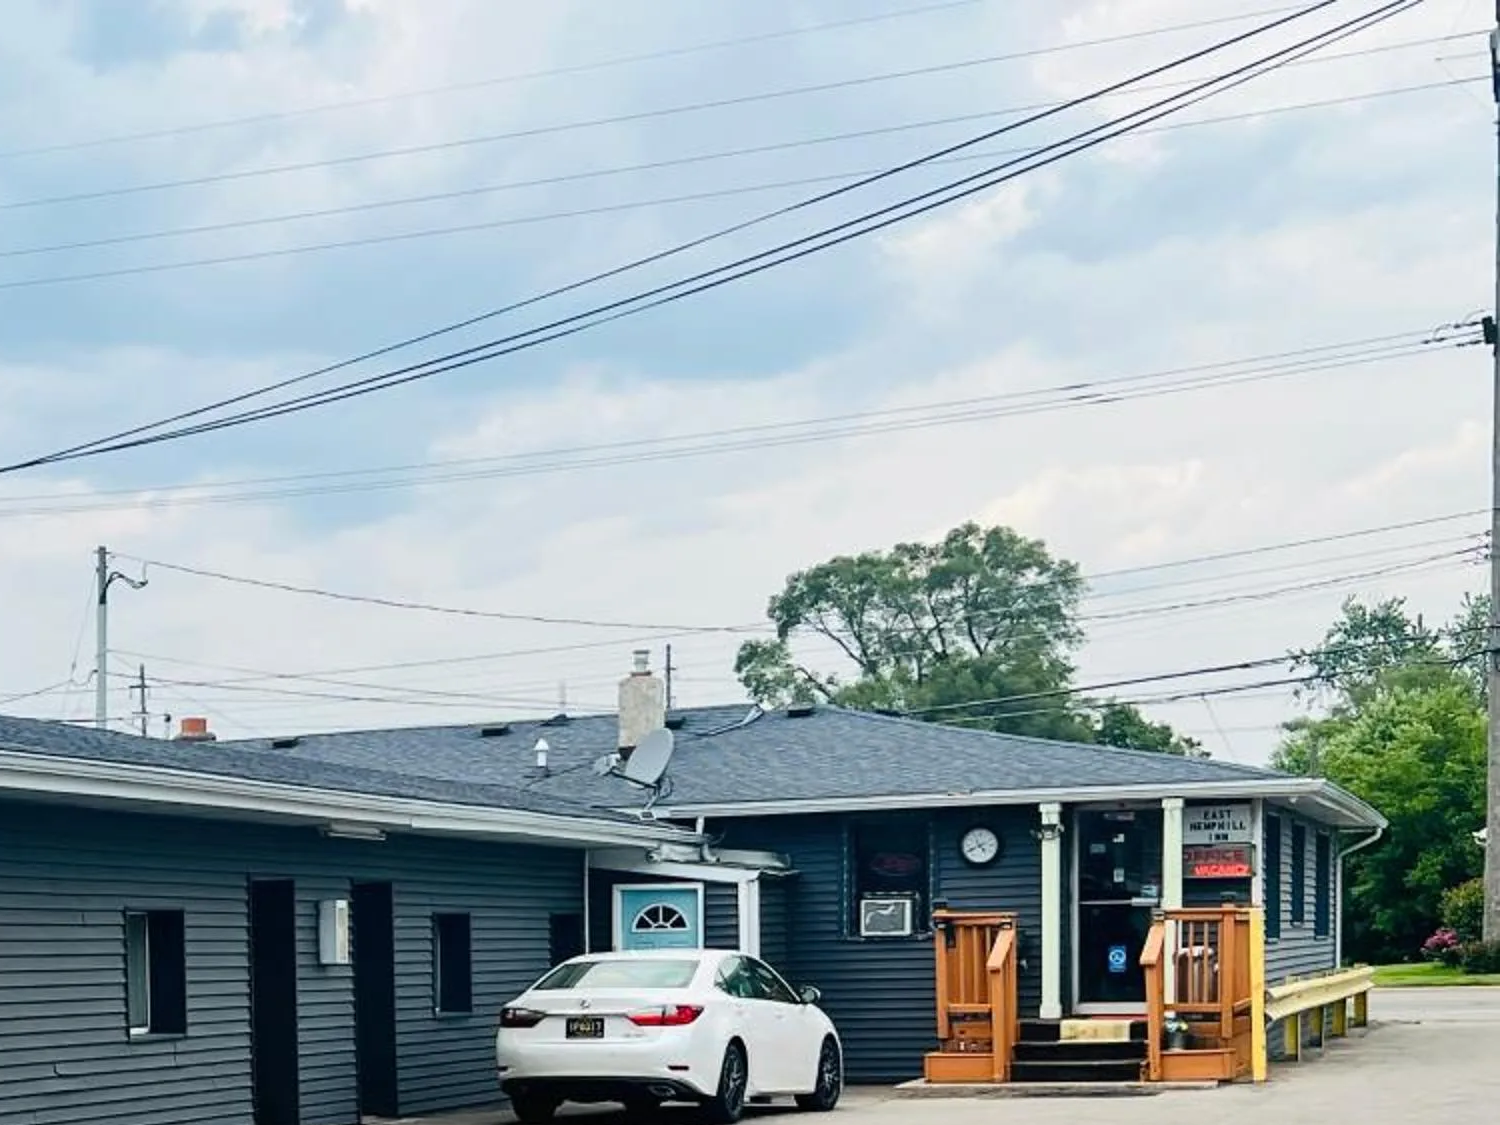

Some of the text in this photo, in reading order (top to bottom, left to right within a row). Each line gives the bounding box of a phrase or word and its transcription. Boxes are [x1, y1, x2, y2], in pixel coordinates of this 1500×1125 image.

[1203, 809, 1233, 819] EAST
[1189, 821, 1246, 832] HEMPHILL
[1208, 833, 1229, 841] INN
[1193, 863, 1250, 876] VACANCY
